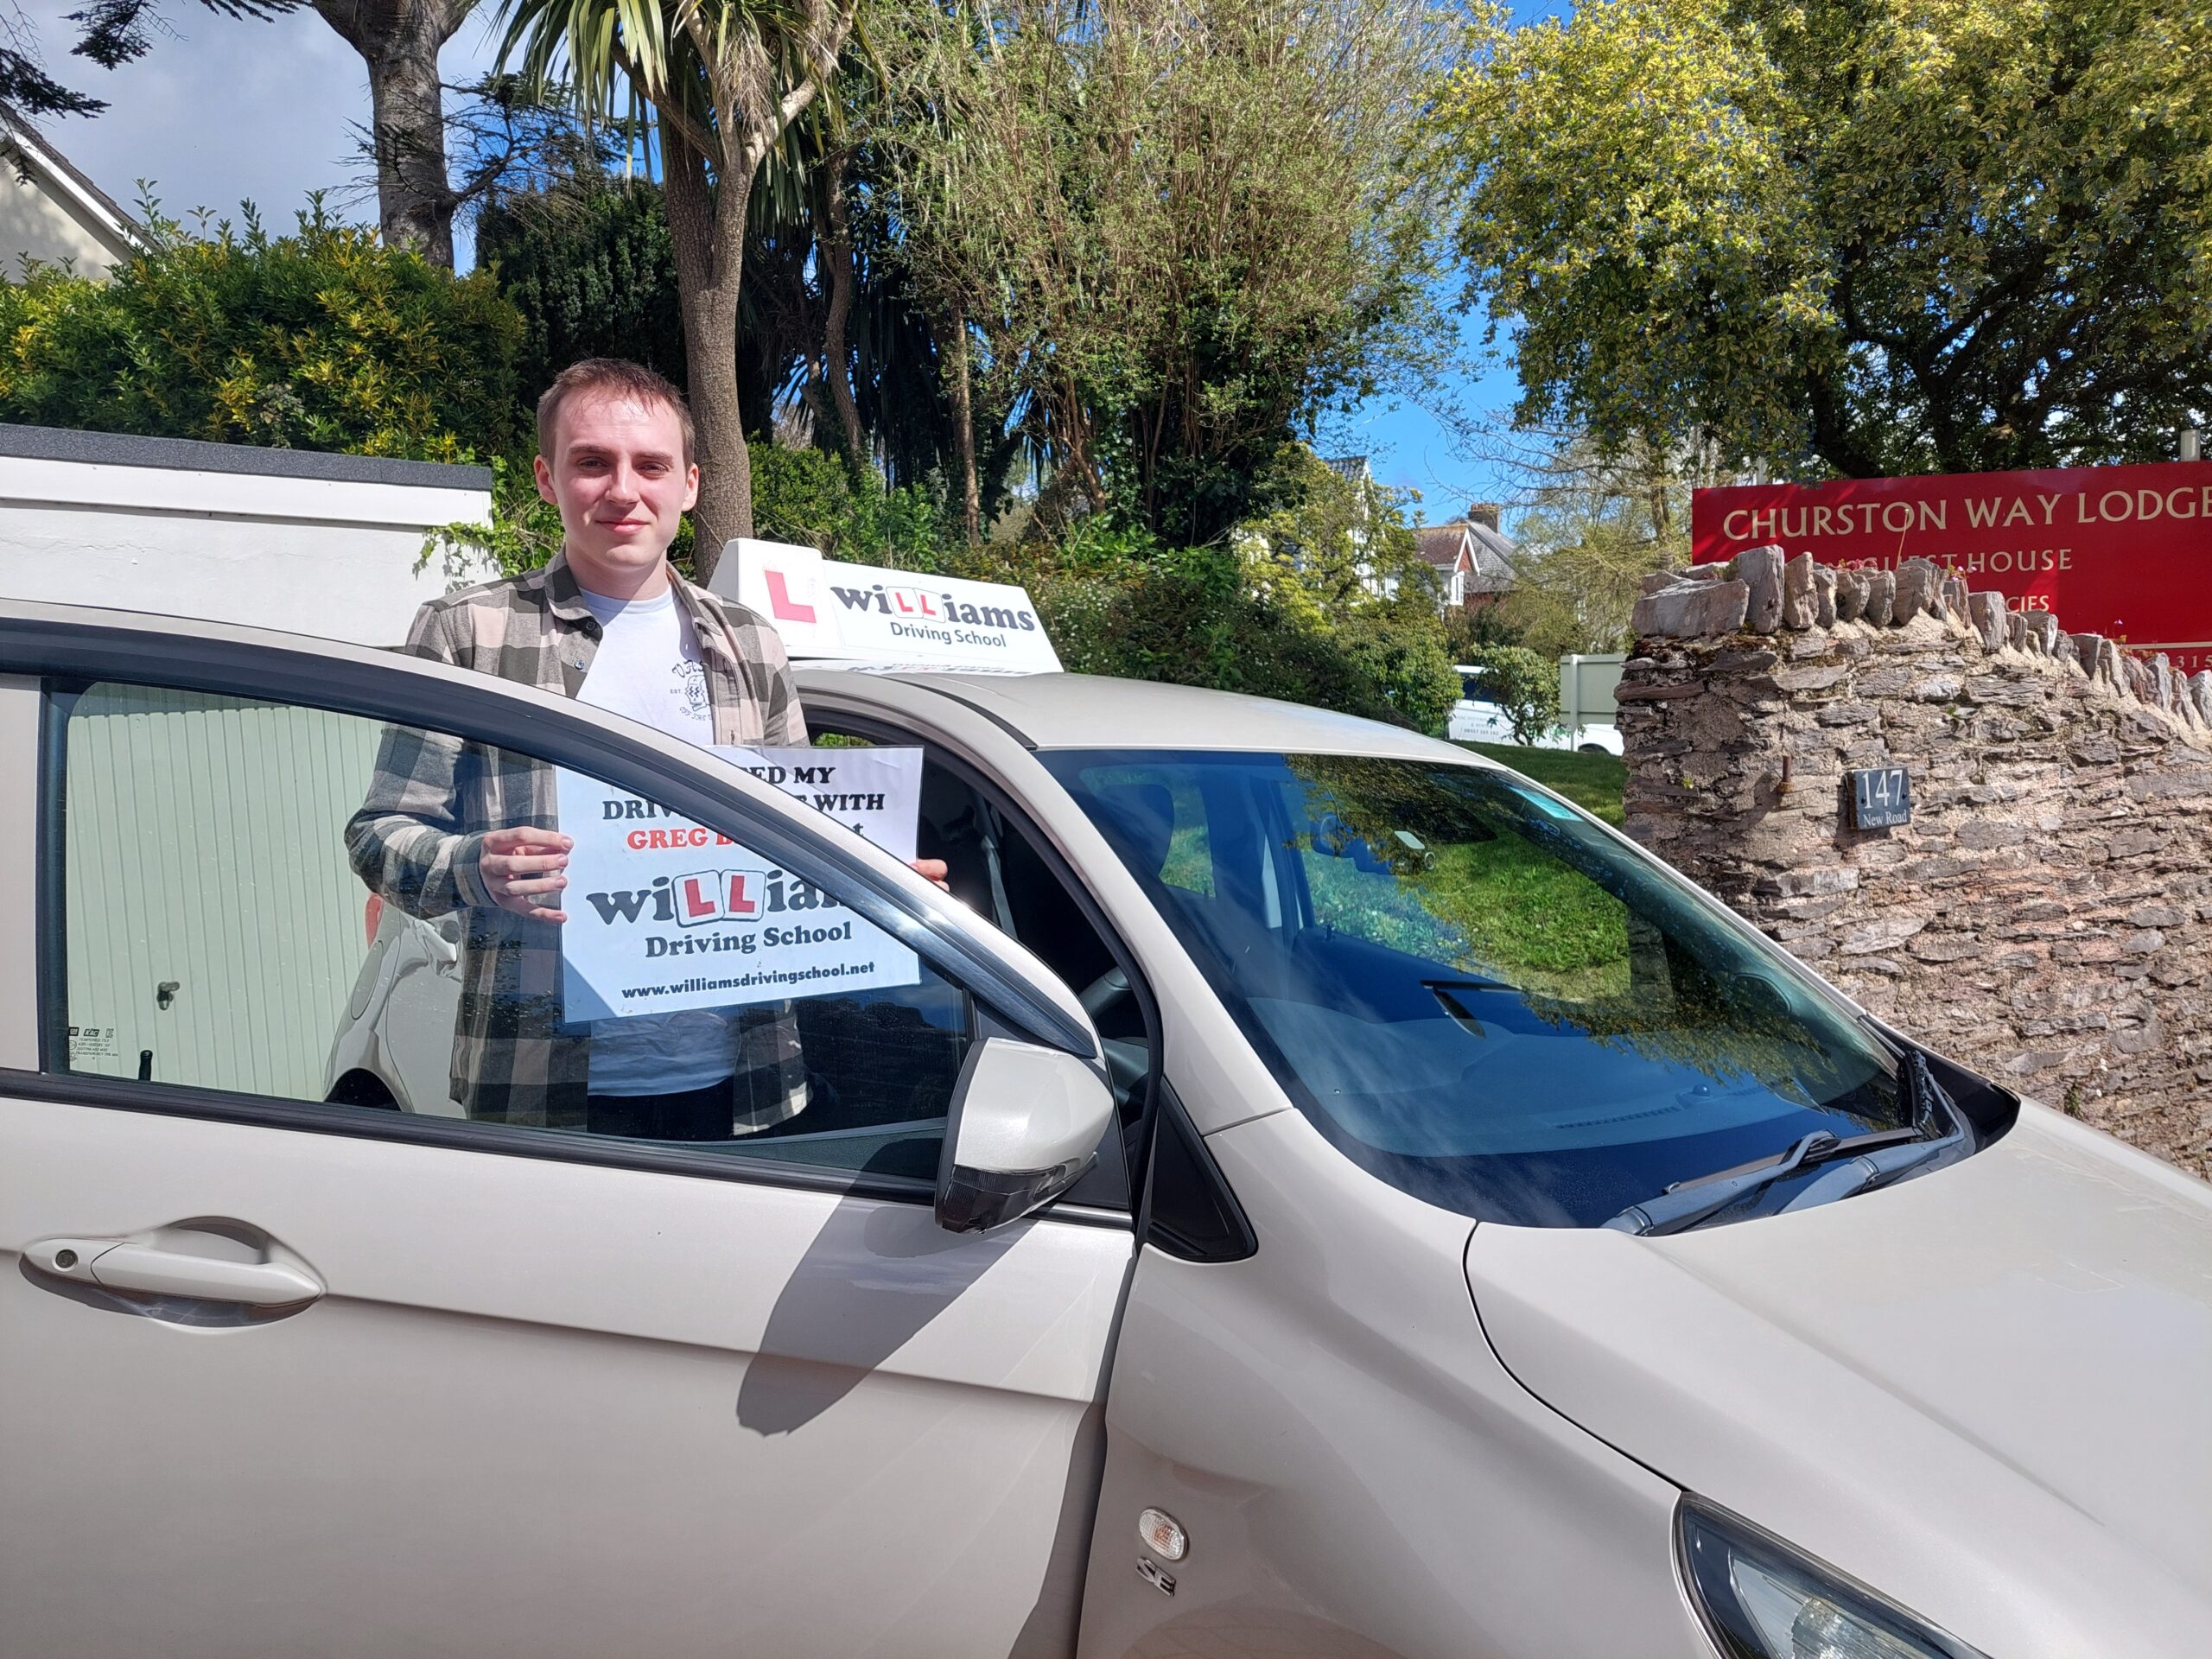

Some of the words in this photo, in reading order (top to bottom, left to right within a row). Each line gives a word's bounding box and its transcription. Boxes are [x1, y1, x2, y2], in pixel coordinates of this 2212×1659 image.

[1723, 499, 1948, 541] CHURSTON
[1963, 493, 2063, 529] WAY
[2077, 486, 2212, 524] LODGE
[1967, 548, 2074, 573] HOUSE
[764, 569, 817, 624] L
[889, 621, 952, 645] Driving
[954, 629, 1007, 648] School
[793, 766, 836, 784] MY
[813, 793, 885, 812] WITH
[1861, 769, 1904, 810] 147
[1863, 813, 1884, 827] New
[1885, 809, 1908, 824] Road
[626, 828, 709, 851] GREG
[645, 931, 756, 959] Driving
[762, 920, 853, 948] School
[621, 961, 876, 1000] www.williamsdrivingschool.net
